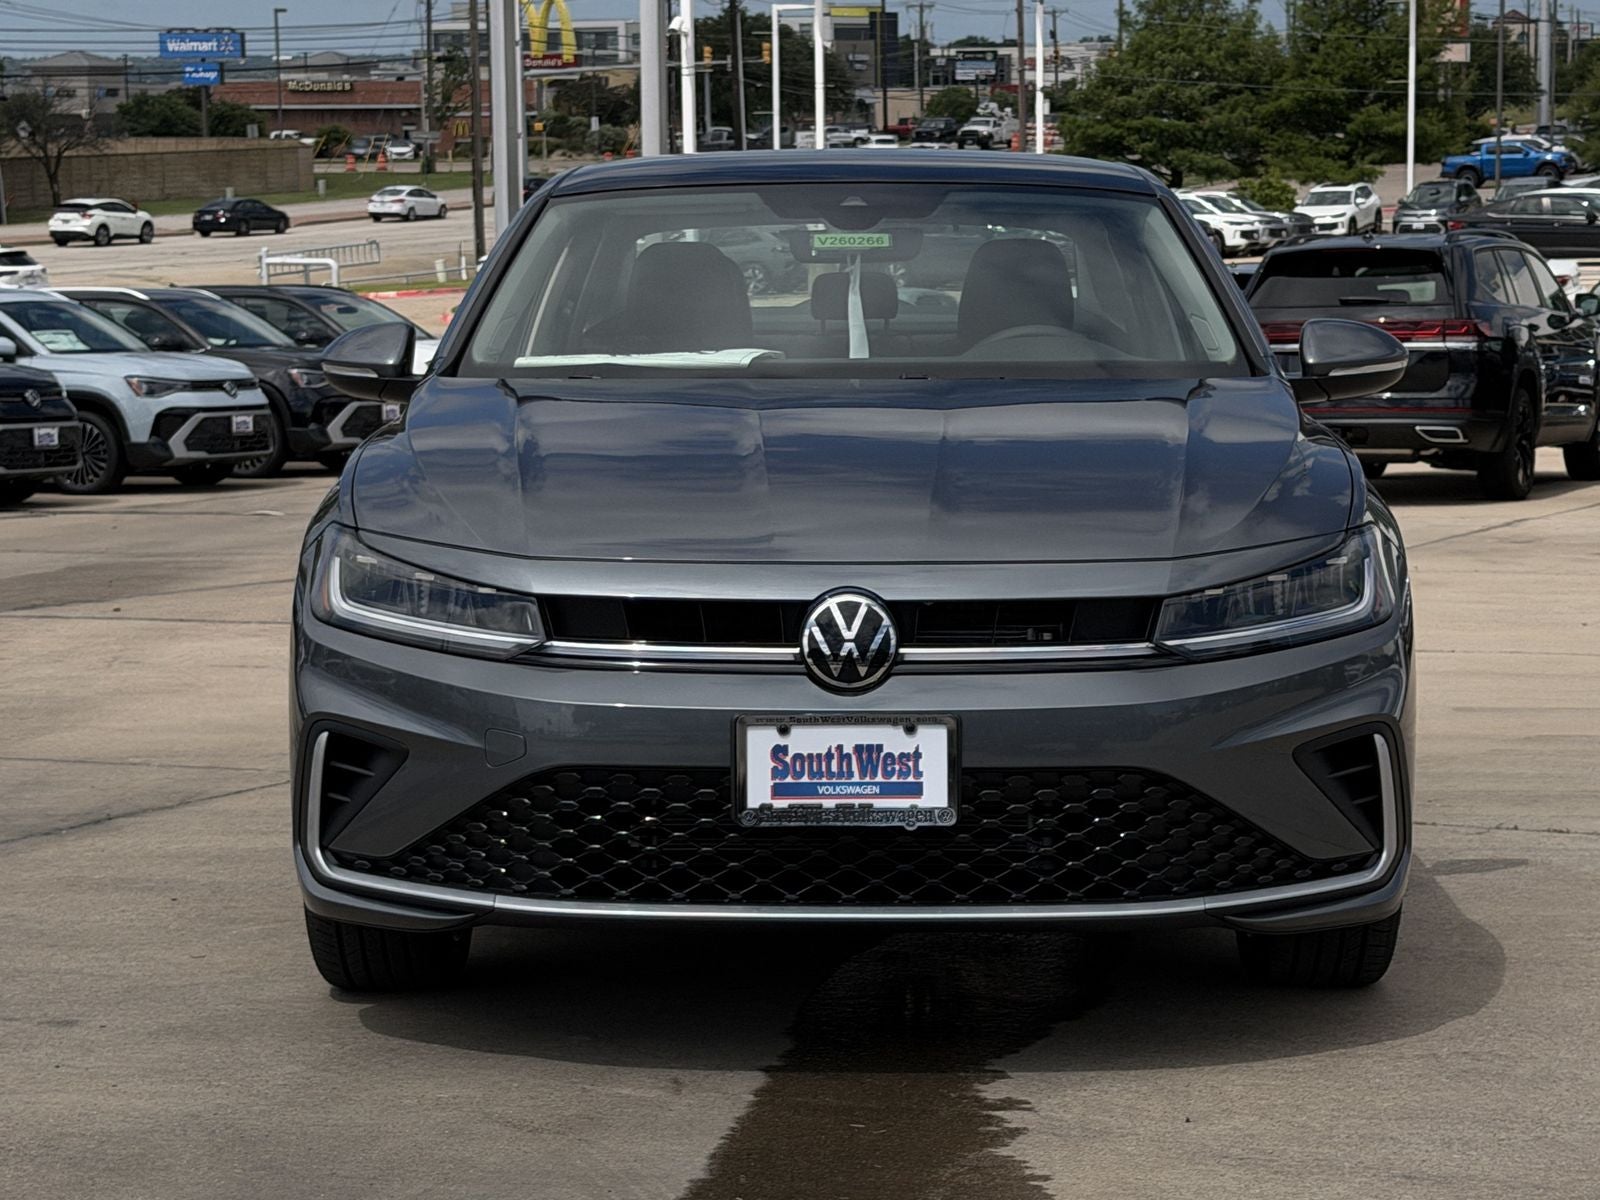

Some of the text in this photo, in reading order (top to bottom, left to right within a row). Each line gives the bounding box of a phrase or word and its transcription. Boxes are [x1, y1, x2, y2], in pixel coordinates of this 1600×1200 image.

[167, 38, 218, 52] Walmart
[816, 236, 885, 246] V260266
[817, 784, 881, 795] VOLKSWAGEN
